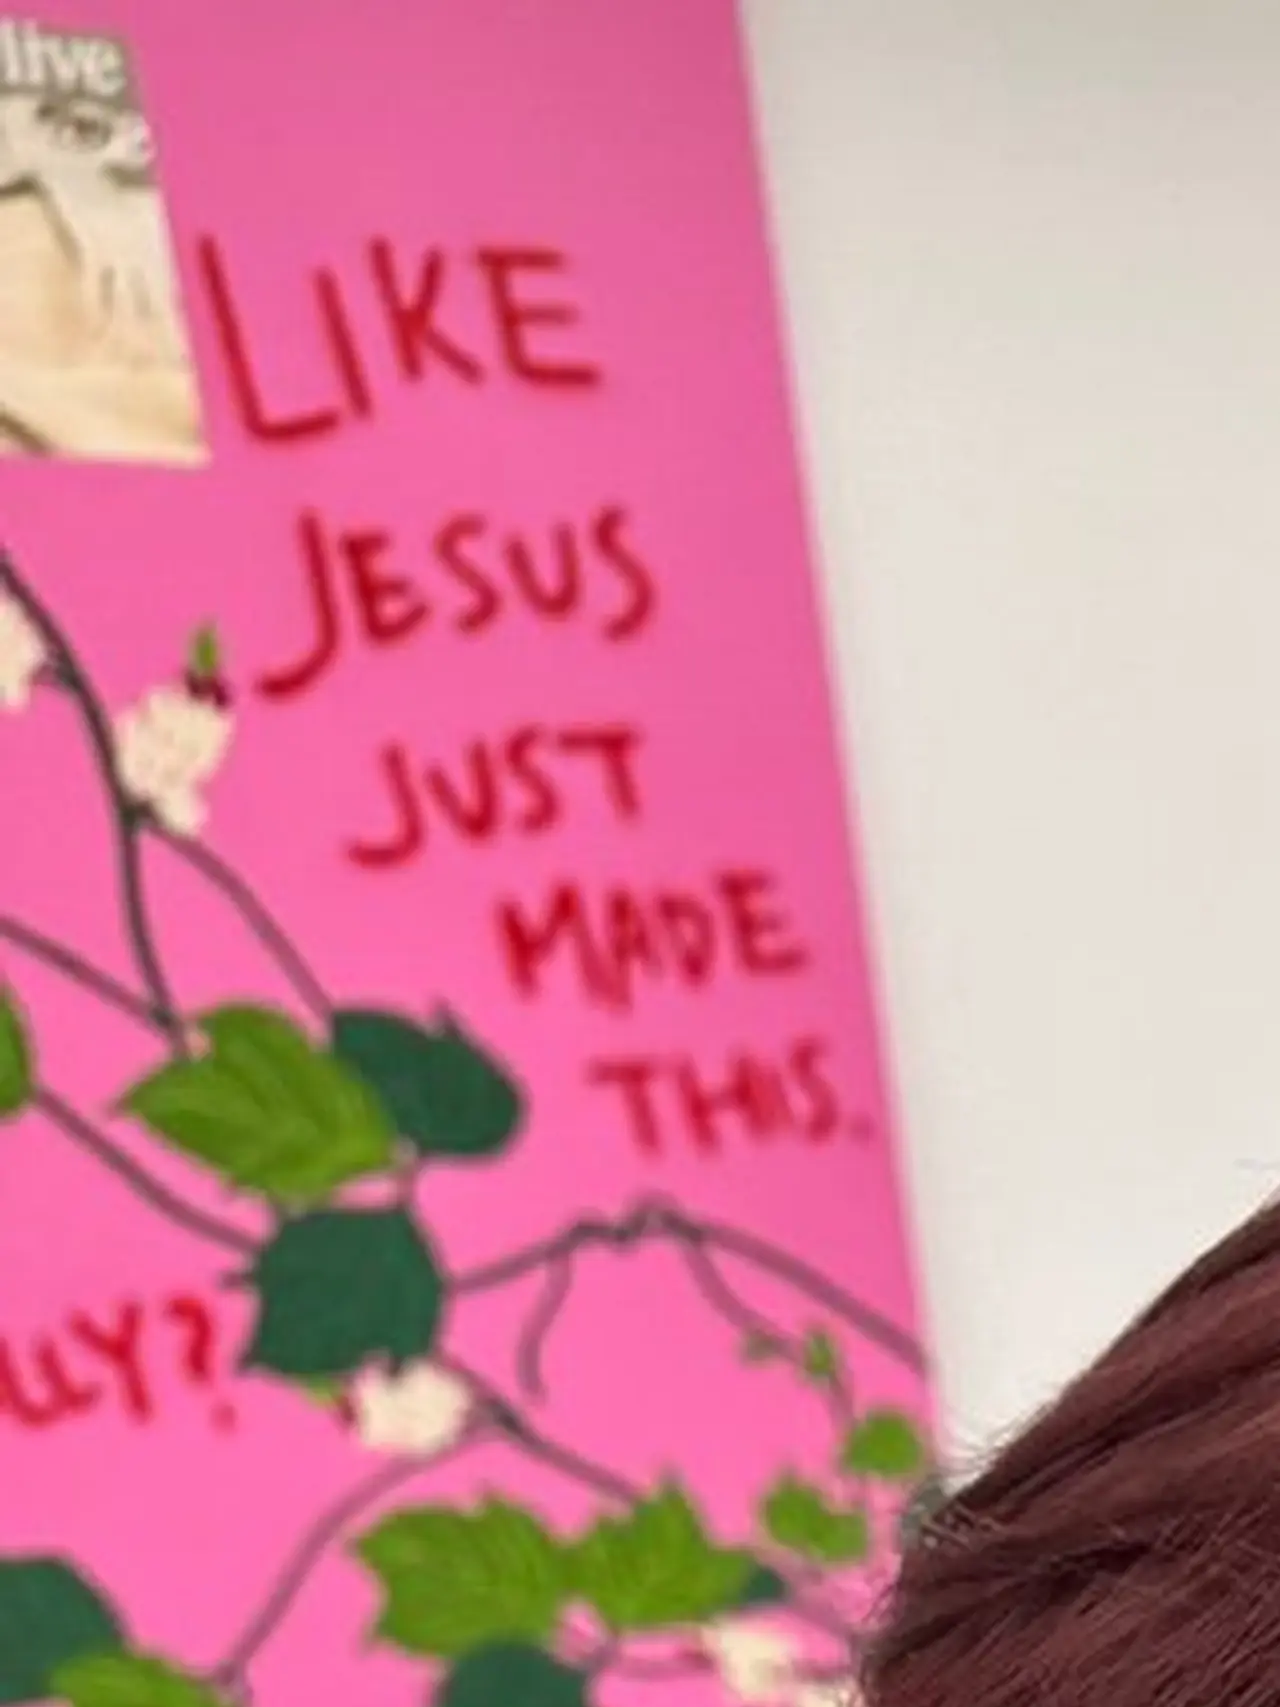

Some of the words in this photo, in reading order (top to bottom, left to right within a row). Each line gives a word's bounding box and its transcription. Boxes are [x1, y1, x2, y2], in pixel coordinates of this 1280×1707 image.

[197, 235, 603, 445] LIKE
[252, 506, 656, 703] JESUS
[345, 723, 642, 869] JUST
[494, 868, 807, 1006] MADE
